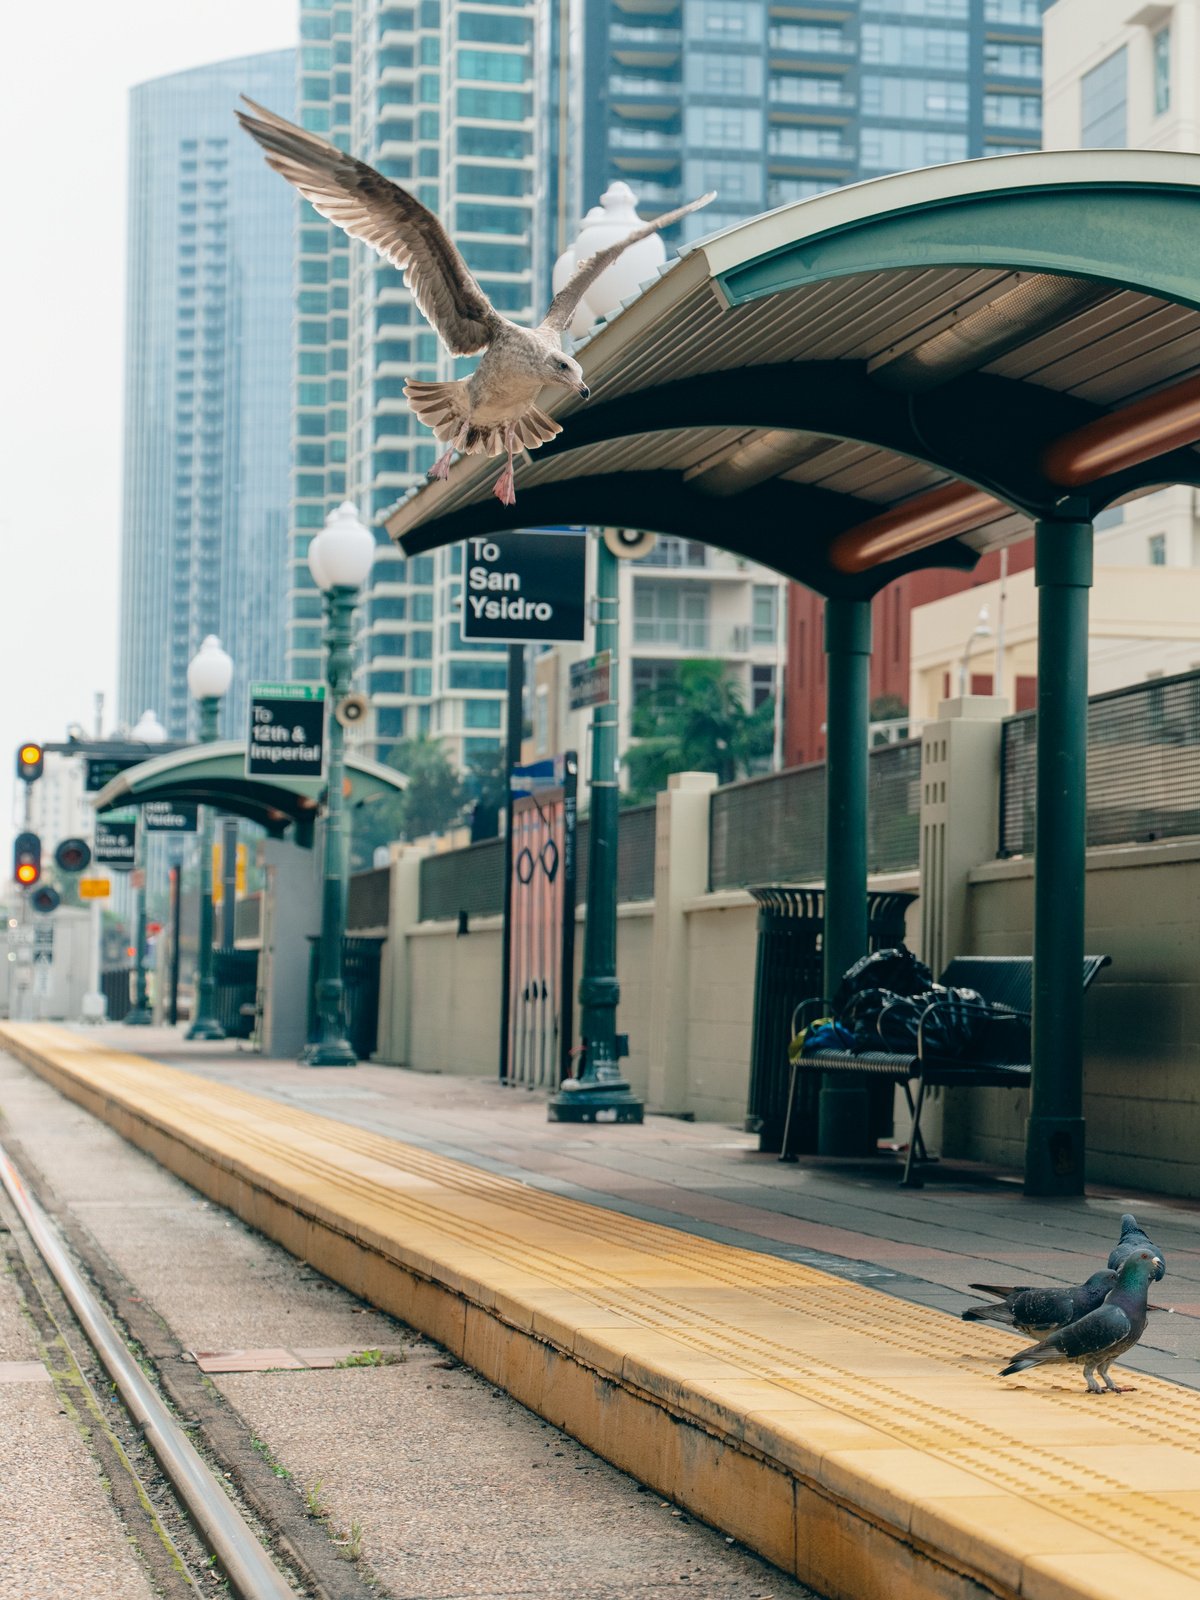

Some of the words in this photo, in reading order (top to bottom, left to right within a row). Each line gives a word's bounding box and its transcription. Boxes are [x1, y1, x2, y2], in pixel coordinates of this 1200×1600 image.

[469, 538, 500, 562] To
[469, 567, 520, 591] San
[469, 596, 553, 620] Ysidro
[253, 706, 273, 724] To
[253, 725, 289, 742] 12th
[291, 726, 306, 743] &
[251, 744, 320, 763] Imperial
[146, 813, 186, 826] Ysidro
